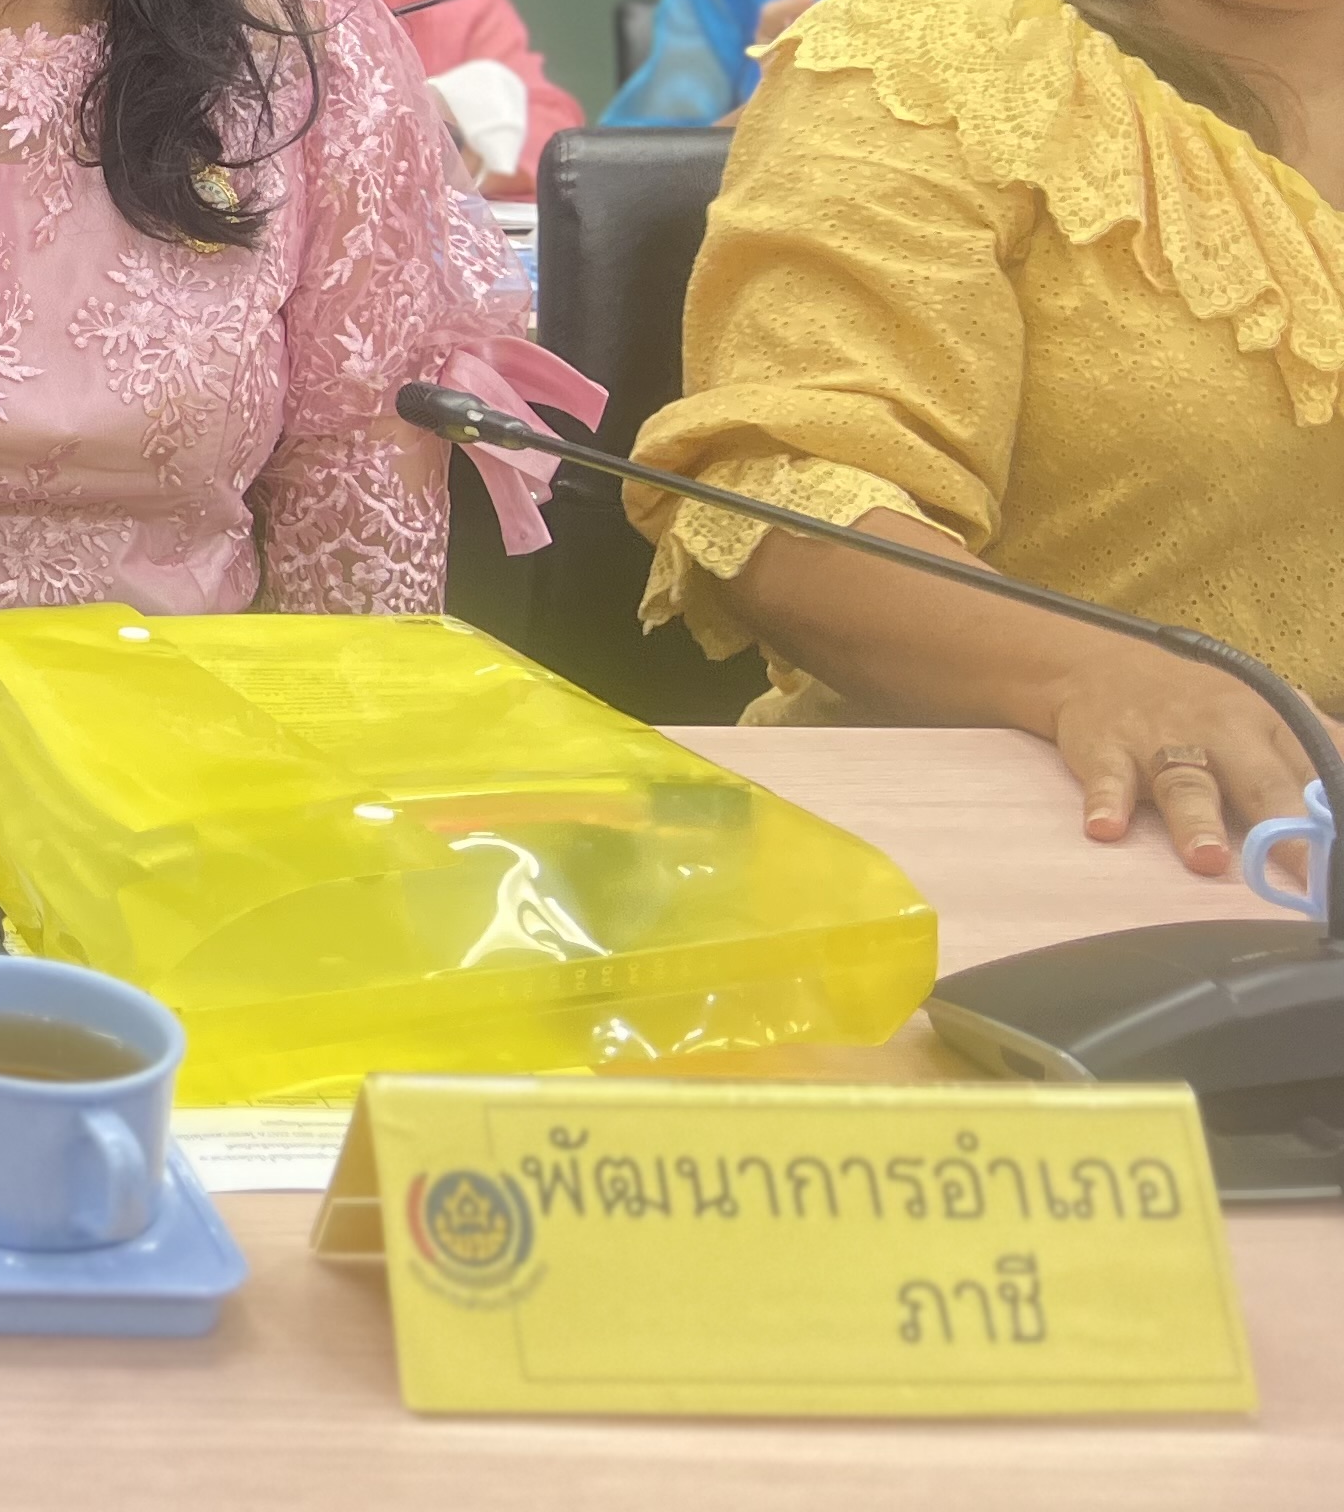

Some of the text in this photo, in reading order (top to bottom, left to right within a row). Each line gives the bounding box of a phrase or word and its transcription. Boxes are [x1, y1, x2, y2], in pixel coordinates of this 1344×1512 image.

[520, 1125, 1184, 1222] พัฒนาการอำเภอ
[896, 1253, 1048, 1345] ภาชี
